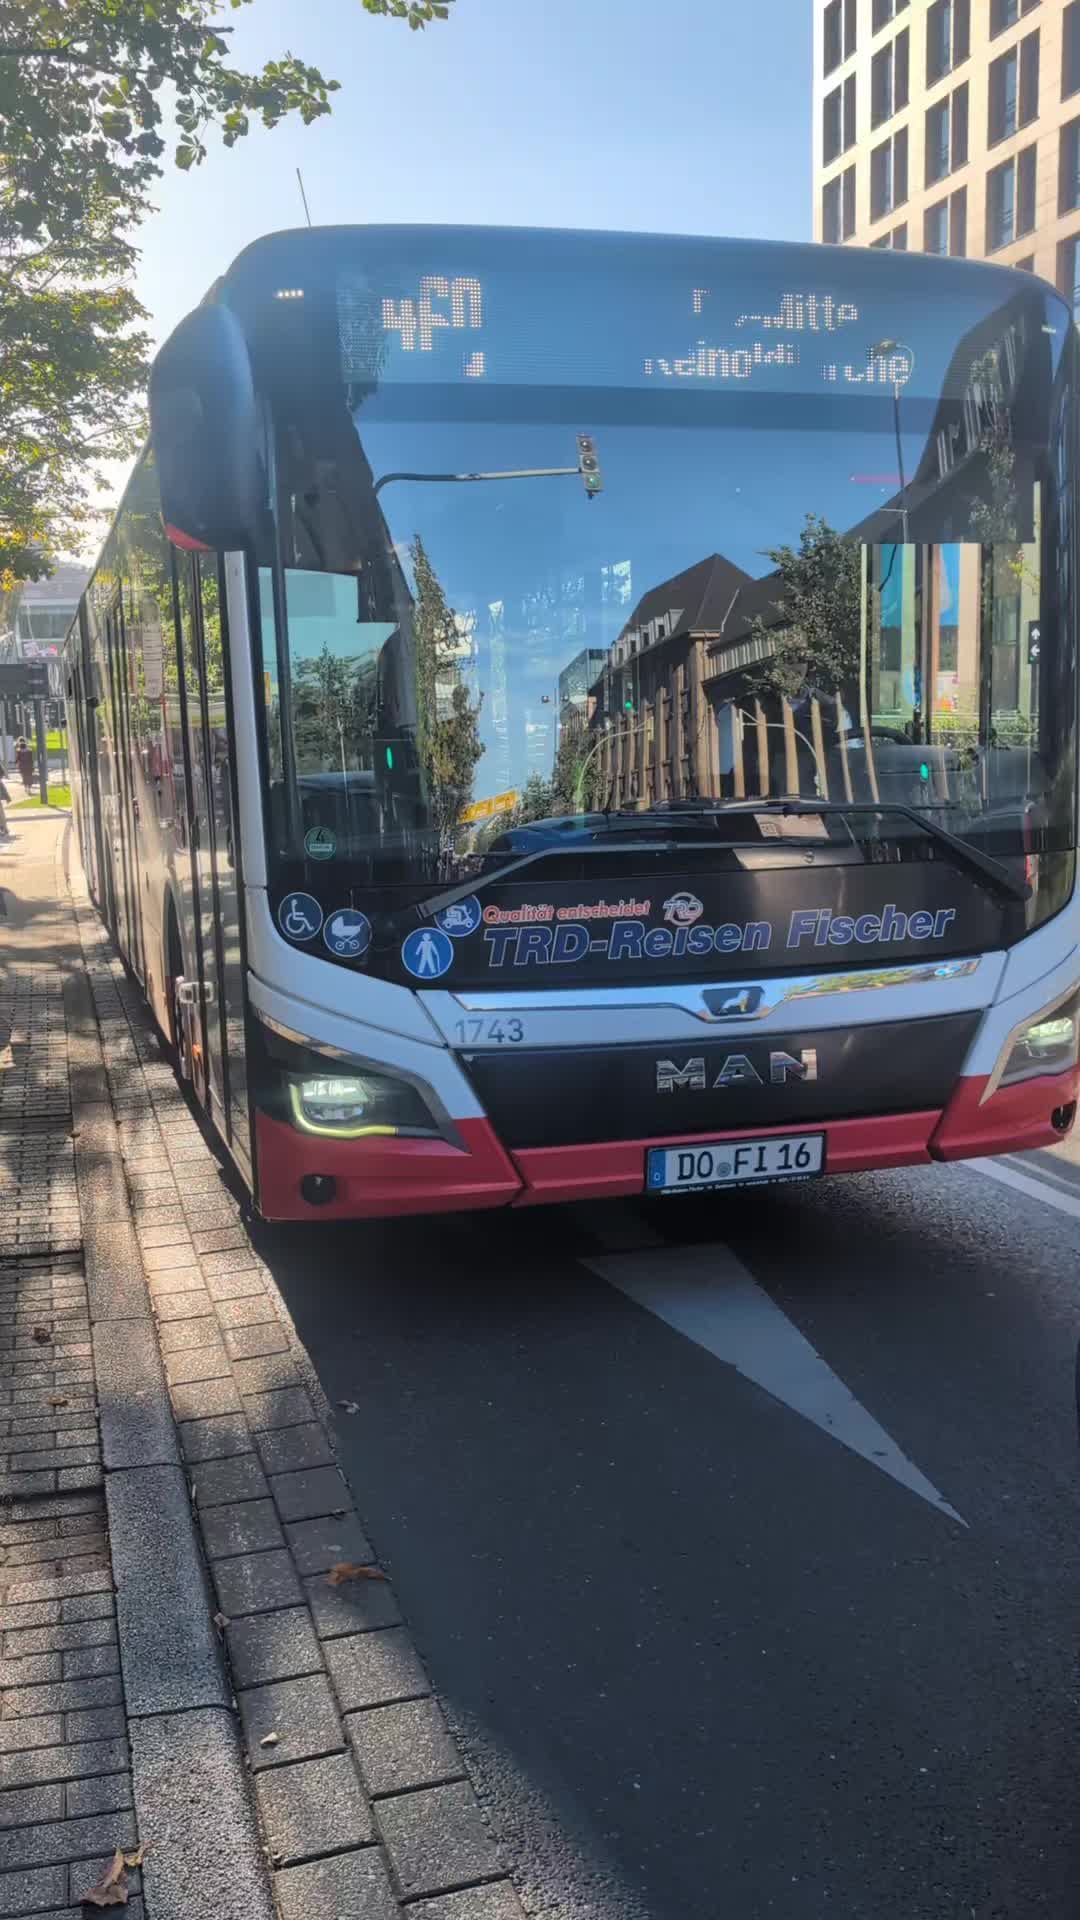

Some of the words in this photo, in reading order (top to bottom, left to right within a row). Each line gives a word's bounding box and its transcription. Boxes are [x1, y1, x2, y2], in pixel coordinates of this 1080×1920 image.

[483, 904, 553, 924] Qualität
[557, 899, 651, 920] entscheidet
[662, 897, 704, 921] TRD
[484, 920, 771, 966] TRD-Reisen
[786, 904, 956, 948] Fischer
[455, 1018, 525, 1043] 1743
[656, 1048, 818, 1093] MAN
[677, 1150, 714, 1180] DO
[735, 1147, 768, 1175] FI
[776, 1142, 811, 1171] 16
